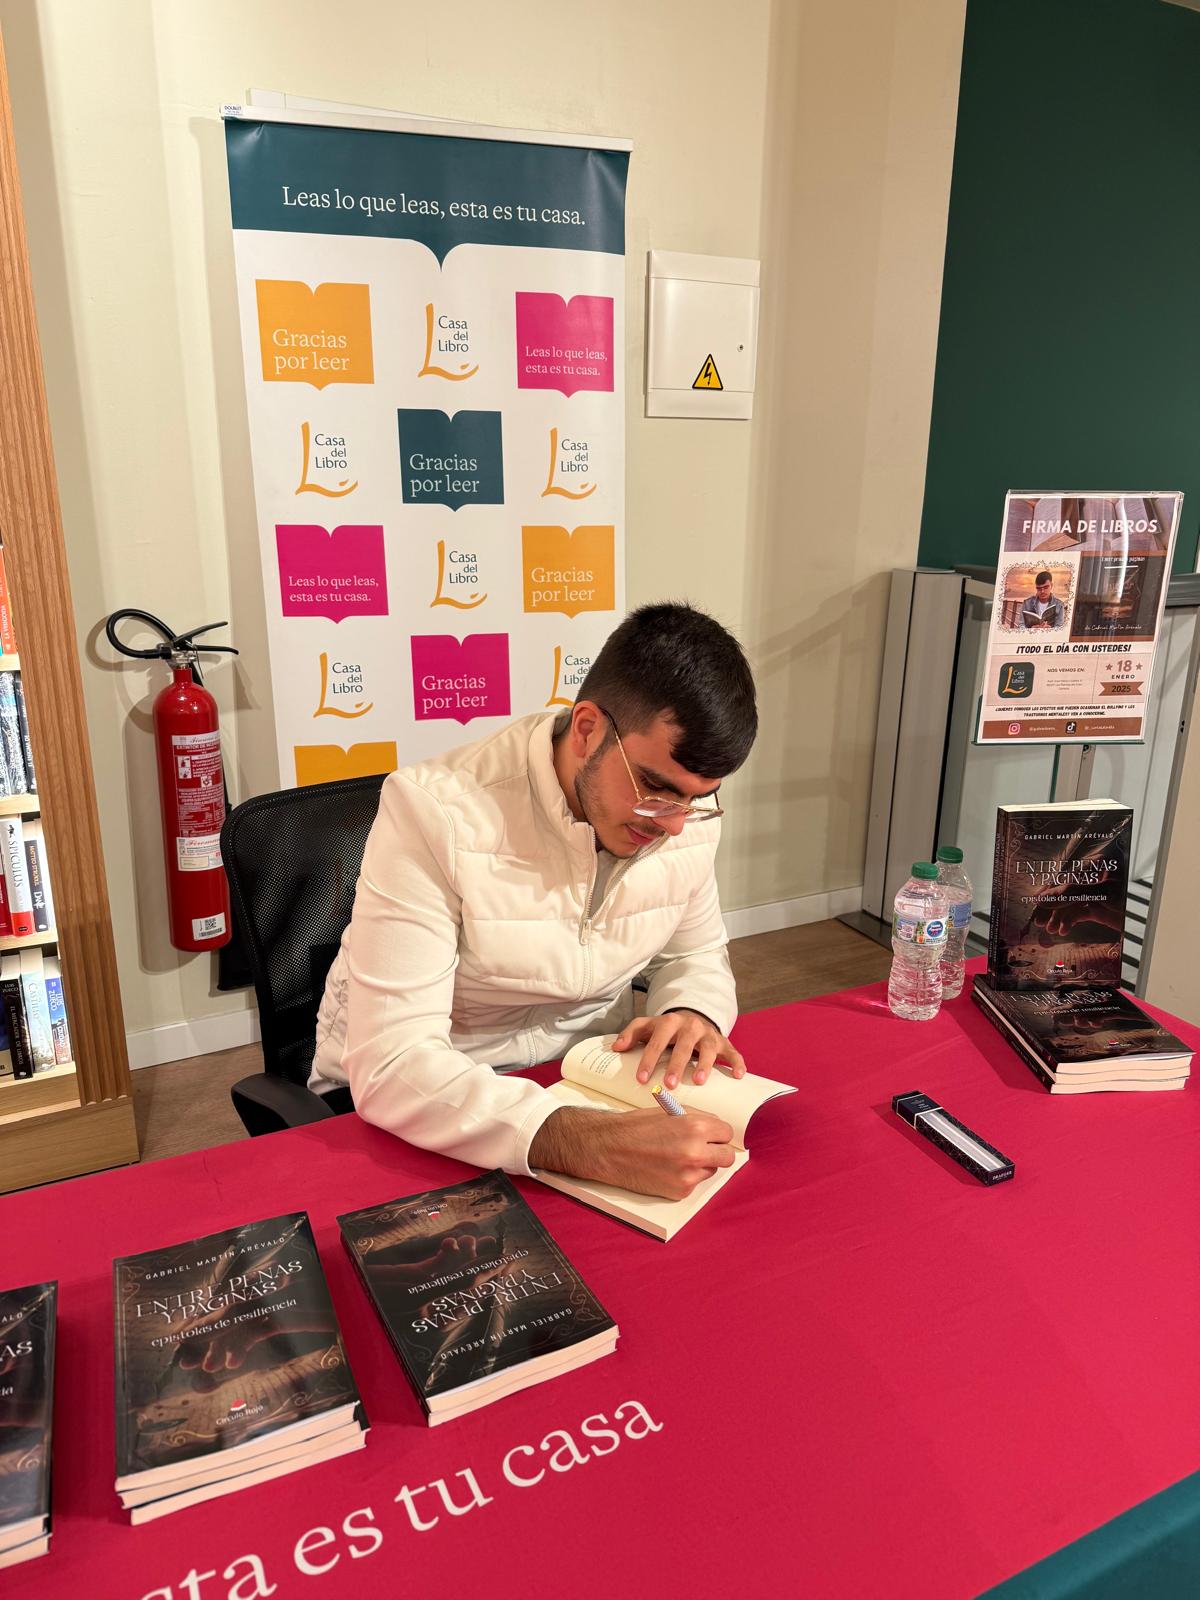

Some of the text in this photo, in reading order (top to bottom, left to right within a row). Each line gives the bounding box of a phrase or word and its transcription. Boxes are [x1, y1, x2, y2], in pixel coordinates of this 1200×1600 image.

[282, 186, 585, 226] Leas lo que leas, esta es tu casa.
[438, 315, 468, 330] Casa
[273, 328, 347, 350] Gracias
[453, 331, 469, 341] del
[438, 338, 469, 353] Libro
[274, 350, 350, 374] por leer
[525, 346, 608, 363] Leas lo que leas,
[525, 364, 601, 376] esta es tu casa.
[314, 433, 346, 446] Casa
[561, 438, 588, 451] Casa
[330, 447, 347, 458] del
[574, 452, 589, 462] del
[314, 456, 348, 469] Libro
[409, 453, 478, 472] Gracias
[560, 460, 589, 473] Libro
[410, 474, 480, 497] por leer
[1022, 519, 1158, 534] FIRMA DE LIBROS
[449, 550, 477, 563] Casa
[463, 564, 478, 574] del
[531, 567, 594, 584] Gracias
[288, 575, 379, 591] Leas lo que leas,
[449, 572, 479, 585] Libro
[289, 592, 372, 602] esta es tu casa.
[532, 585, 596, 607] por leer
[1016, 643, 1132, 654] ¡TODO EL DÍA CON USTEDES!
[564, 655, 591, 666] Casa
[1116, 660, 1133, 673] 18
[332, 662, 362, 675] Casa
[347, 674, 362, 684] del
[422, 674, 486, 691] Gracias
[564, 674, 585, 685] Libr
[332, 682, 363, 694] Libro
[1111, 684, 1132, 693] 2025
[422, 692, 488, 714] por leer
[9, 841, 23, 888] SPICULUS
[1016, 859, 1118, 873] ENTRE PENAS
[1030, 873, 1039, 886] Y
[1057, 894, 1068, 902] de
[1068, 894, 1107, 902] resiliencia
[145, 1264, 191, 1280] GABRIEL
[240, 1237, 286, 1254] ARÉVALO
[465, 1266, 481, 1276] de
[520, 1269, 535, 1284] Y
[136, 1260, 303, 1318] ENTRE PENAS
[408, 1269, 465, 1295] resiliencia
[411, 1272, 563, 1334] ENTRE PENAS
[161, 1309, 176, 1324] Y
[214, 1318, 232, 1330] de
[234, 1299, 297, 1325] resiliencia
[532, 1307, 572, 1327] GABRIEL
[440, 1337, 486, 1360] ARÉVALO
[141, 1400, 664, 1600] ta es tu casa
